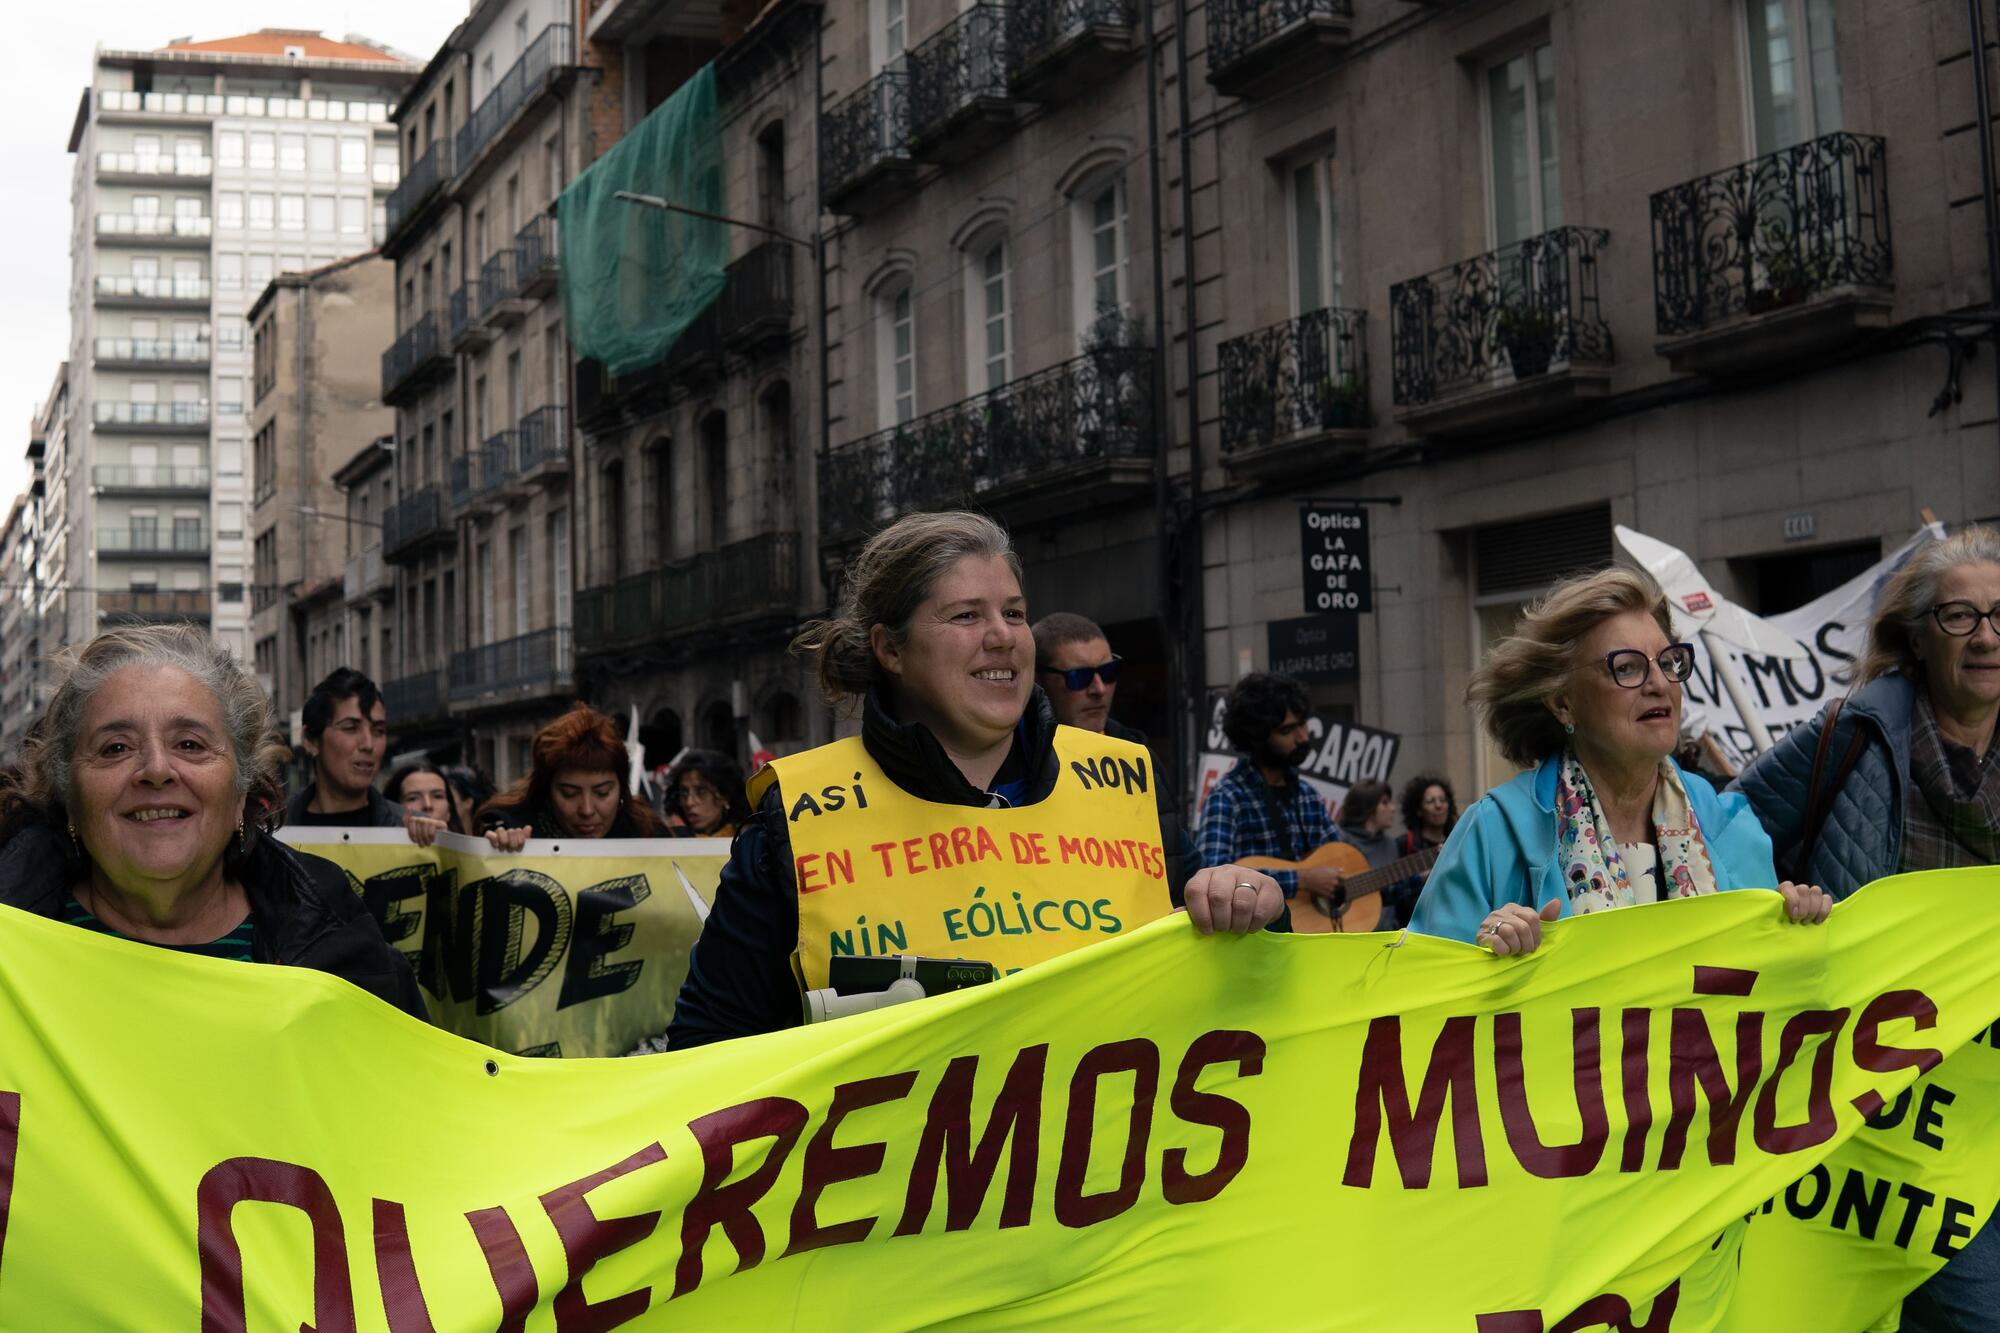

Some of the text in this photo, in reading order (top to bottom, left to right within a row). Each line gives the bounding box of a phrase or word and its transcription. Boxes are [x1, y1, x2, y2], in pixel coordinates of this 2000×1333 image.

[1307, 512, 1361, 531] Optica
[1325, 537, 1345, 550] LA
[1310, 554, 1362, 571] GAFA
[1326, 575, 1347, 589] DE
[1317, 592, 1359, 609] ORO
[1071, 756, 1148, 795] NON
[796, 826, 1165, 895] EN TERRA DE MONTES
[345, 862, 651, 1016] ENDE
[196, 1029, 1267, 1333] QUEREMOS
[1342, 964, 1942, 1189] MUIÑOS
[1752, 1163, 1975, 1260] ONTE
